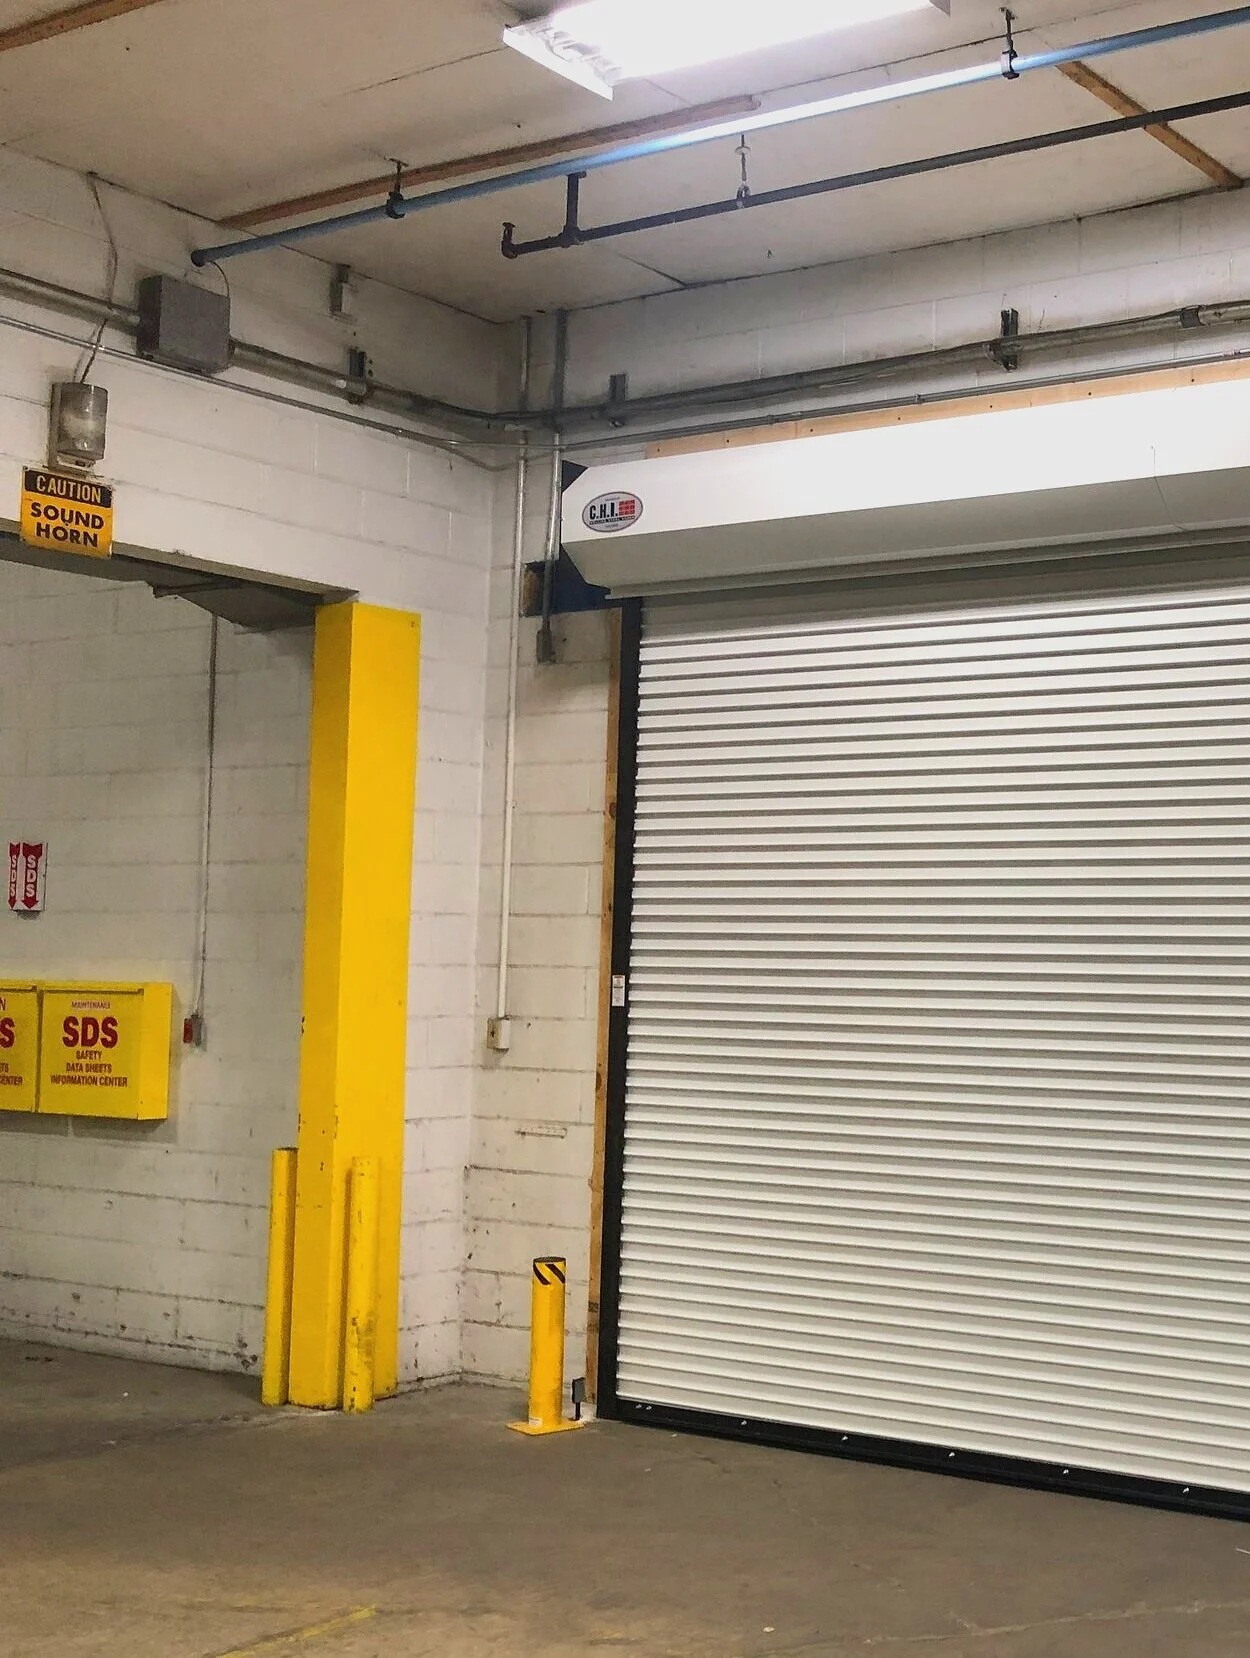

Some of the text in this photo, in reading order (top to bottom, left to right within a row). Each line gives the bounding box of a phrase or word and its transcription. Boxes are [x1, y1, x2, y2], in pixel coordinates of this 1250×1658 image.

[36, 475, 101, 503] CAUTION
[30, 502, 104, 530] SOUND
[36, 522, 98, 548] HORN
[26, 854, 36, 897] SDS
[62, 1016, 118, 1049] SDS
[66, 1063, 112, 1073] DATA SHEETS
[76, 1050, 102, 1060] SAFETY
[51, 1075, 128, 1087] INFORMATION CENTER
